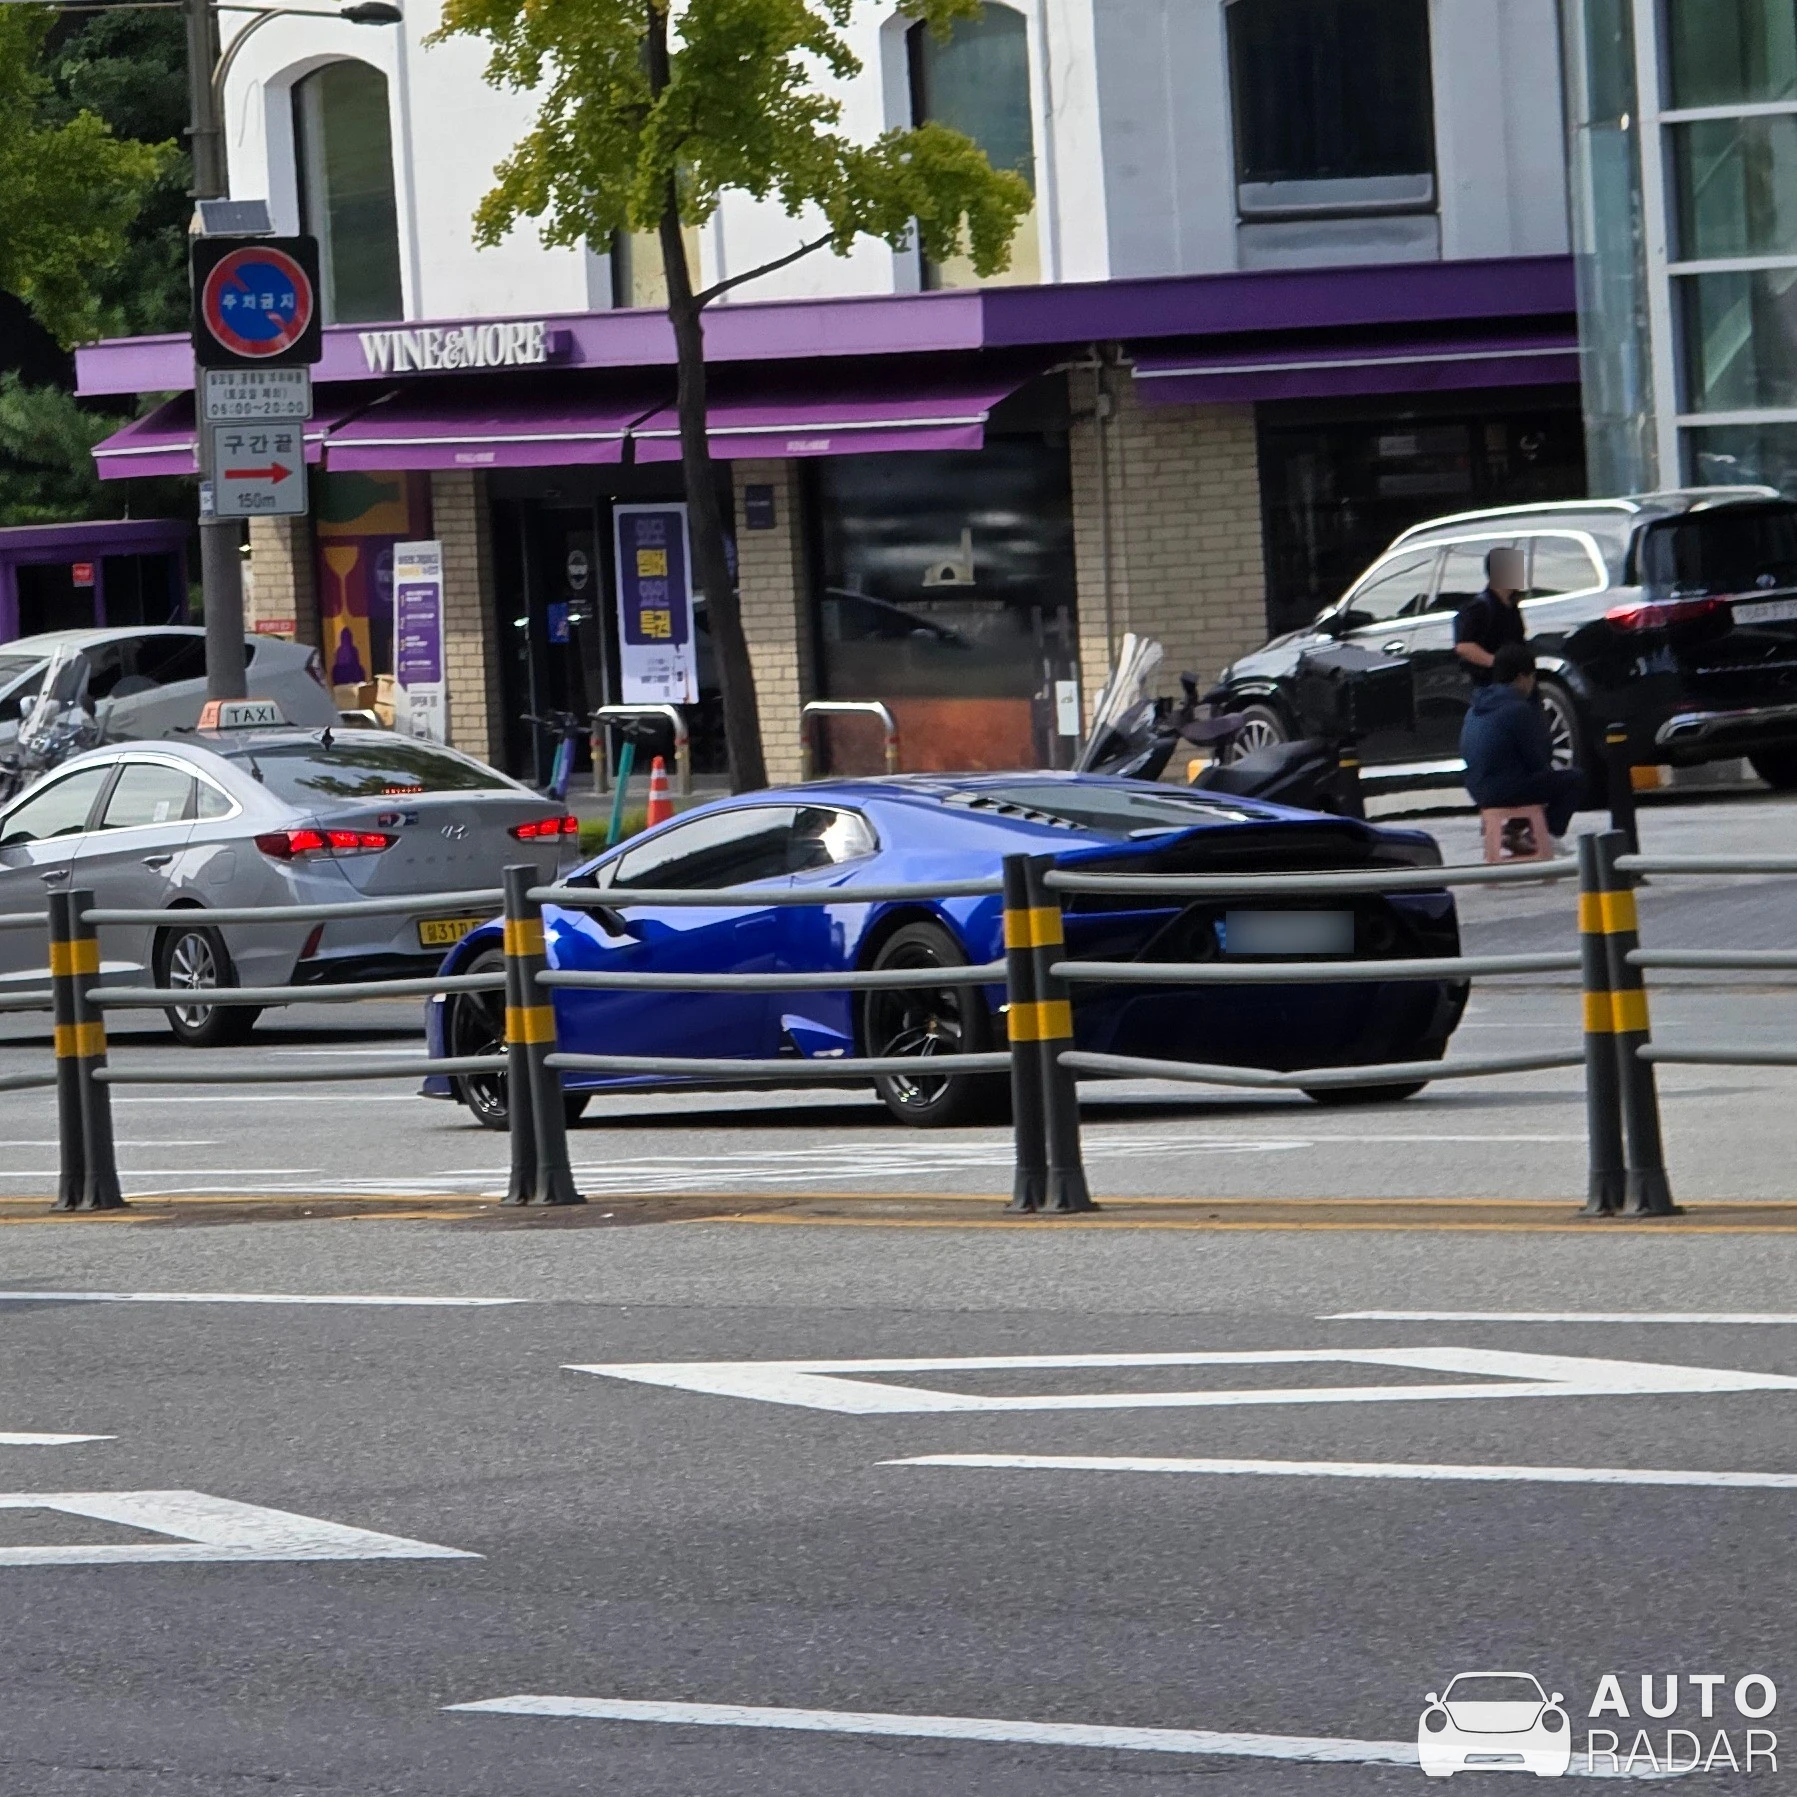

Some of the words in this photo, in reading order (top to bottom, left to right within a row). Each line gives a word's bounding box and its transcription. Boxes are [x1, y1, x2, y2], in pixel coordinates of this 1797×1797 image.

[222, 292, 294, 310] 주차금지
[359, 321, 548, 373] WINE&MORE
[230, 706, 276, 724] TAXI
